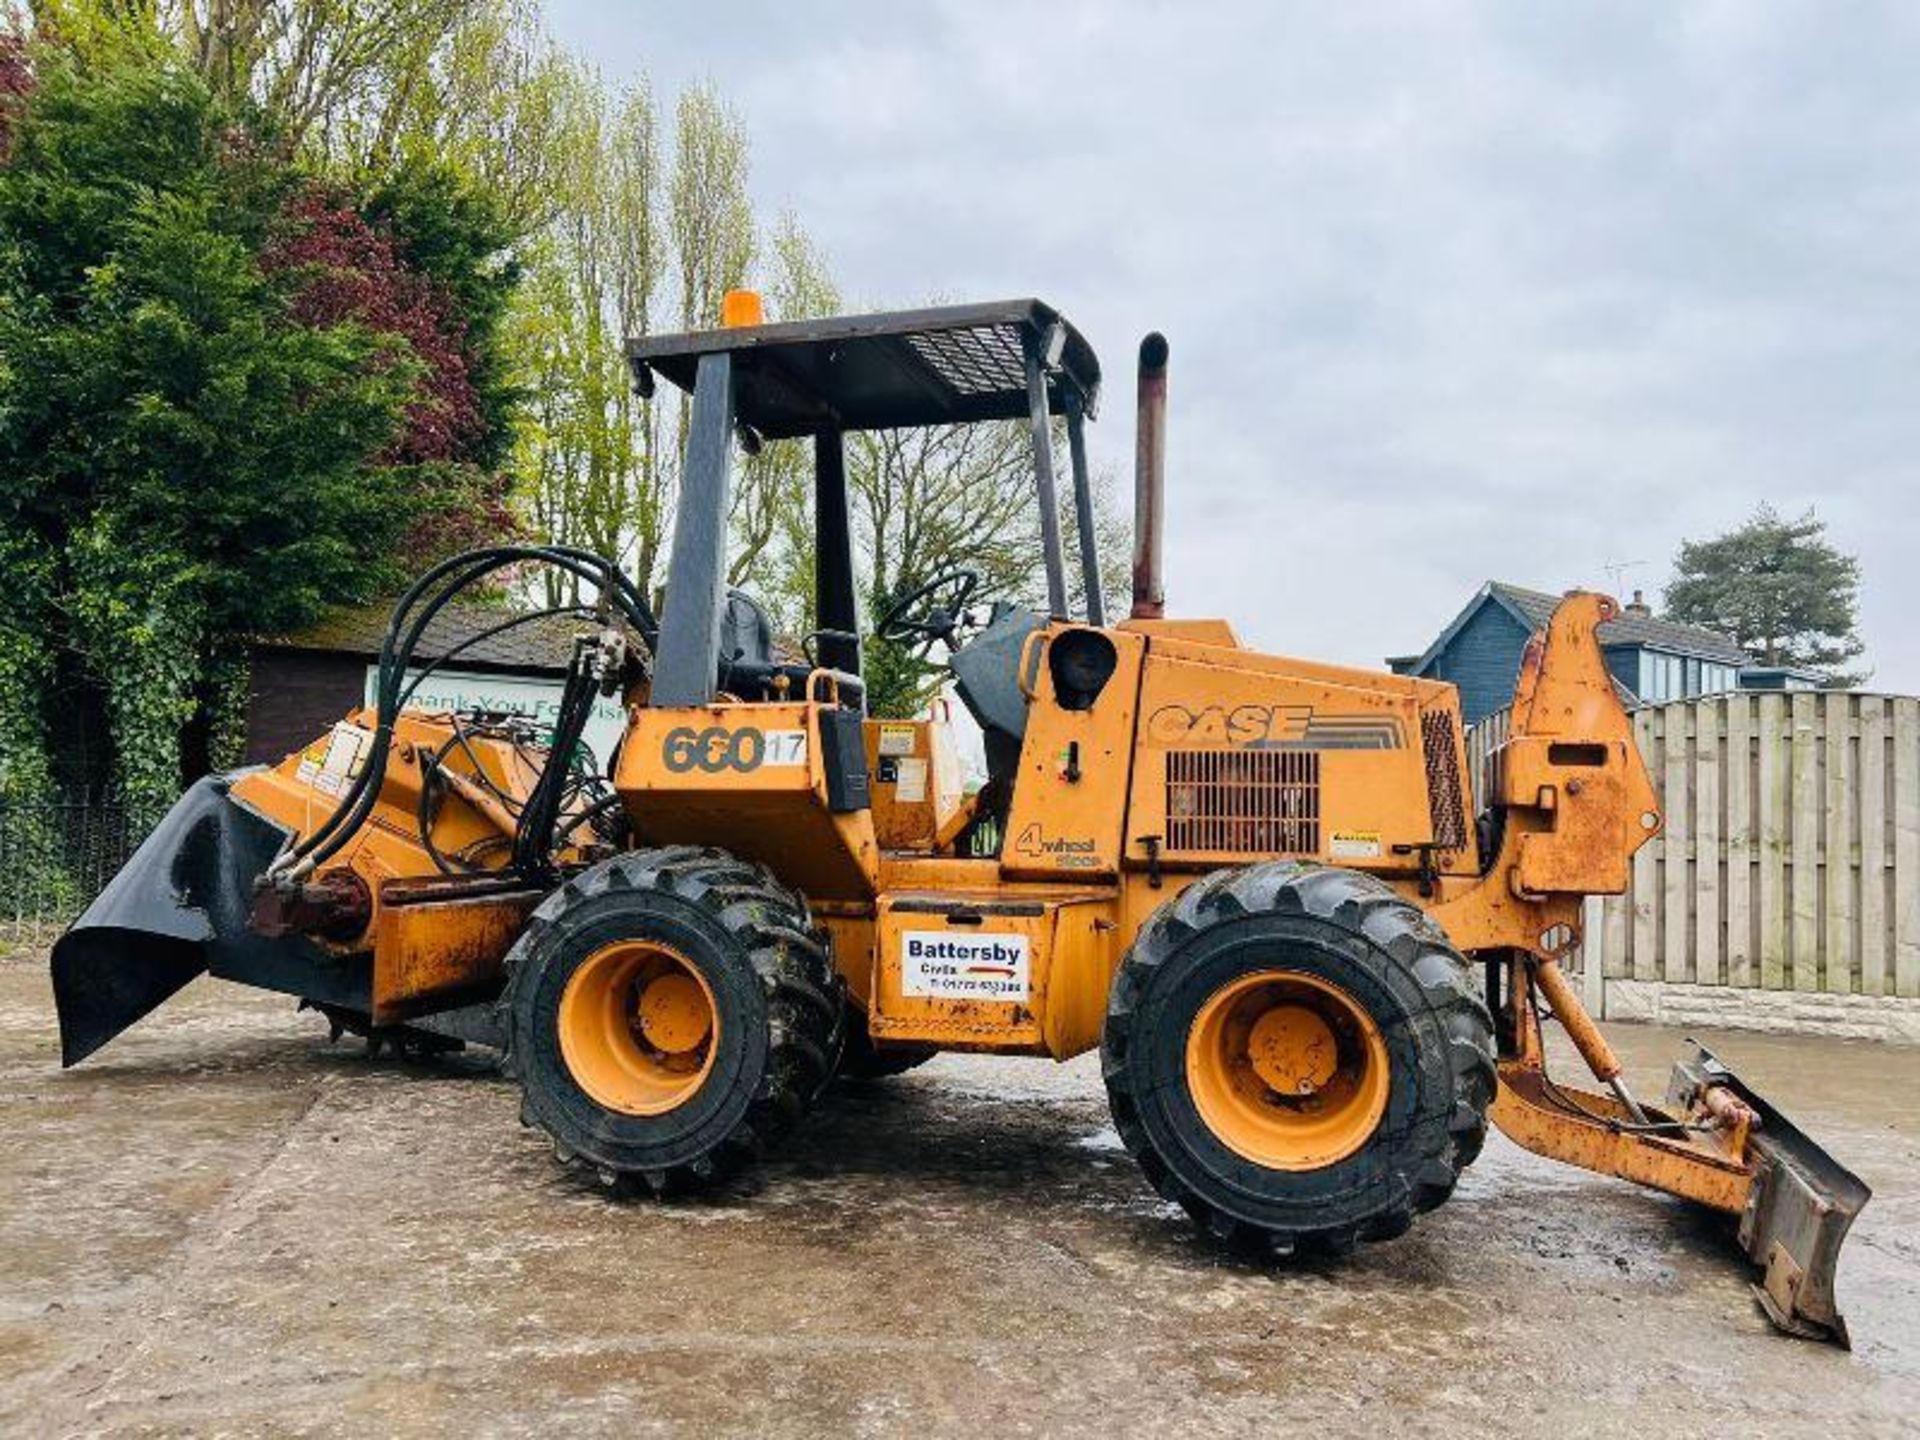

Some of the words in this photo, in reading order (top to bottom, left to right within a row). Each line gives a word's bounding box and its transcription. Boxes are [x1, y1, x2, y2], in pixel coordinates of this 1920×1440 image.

[399, 690, 470, 709] hank
[479, 696, 526, 712] You
[535, 700, 560, 716] Fo
[1147, 704, 1313, 746] CASE
[662, 727, 765, 773] 660
[768, 734, 804, 761] 17
[1016, 823, 1042, 857] 4
[908, 940, 1021, 966] Battersby
